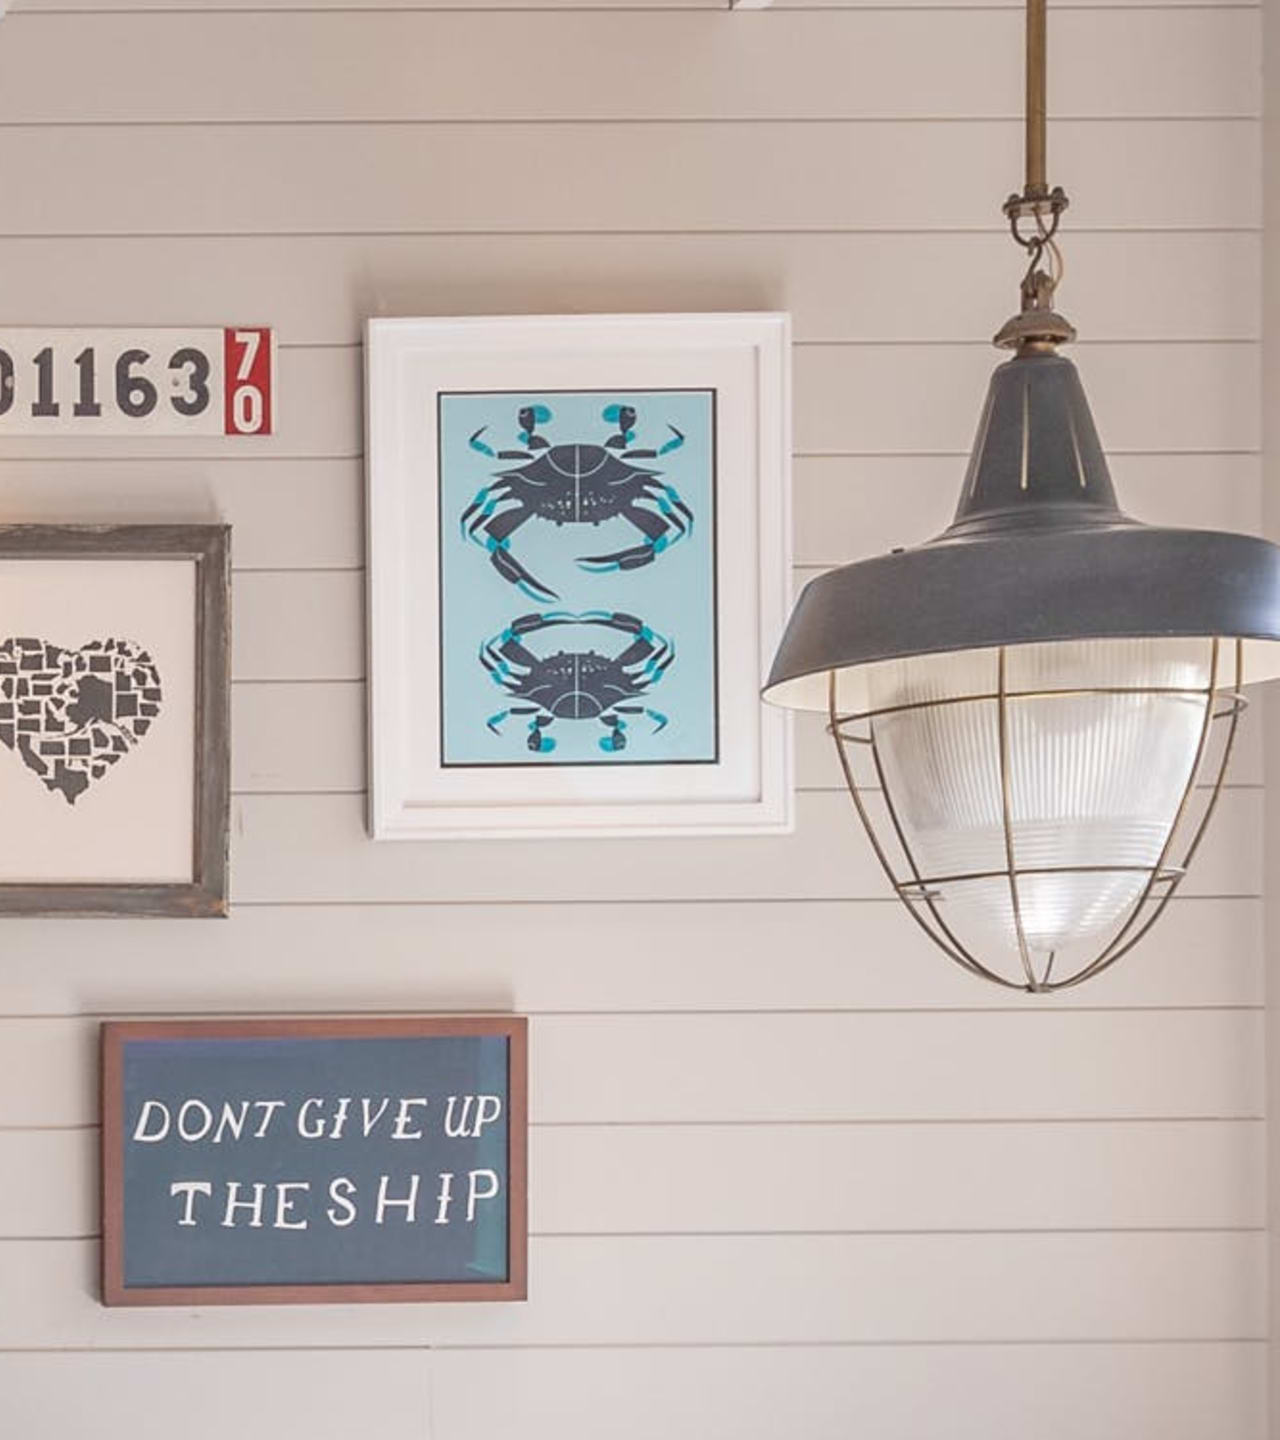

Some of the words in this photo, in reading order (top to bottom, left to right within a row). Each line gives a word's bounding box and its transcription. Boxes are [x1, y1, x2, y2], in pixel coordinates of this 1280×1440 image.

[133, 1099, 286, 1142] DONT
[297, 1097, 428, 1139] GIVE
[444, 1094, 502, 1138] UP
[170, 1181, 310, 1230] THE
[326, 1168, 499, 1227] SHIP
